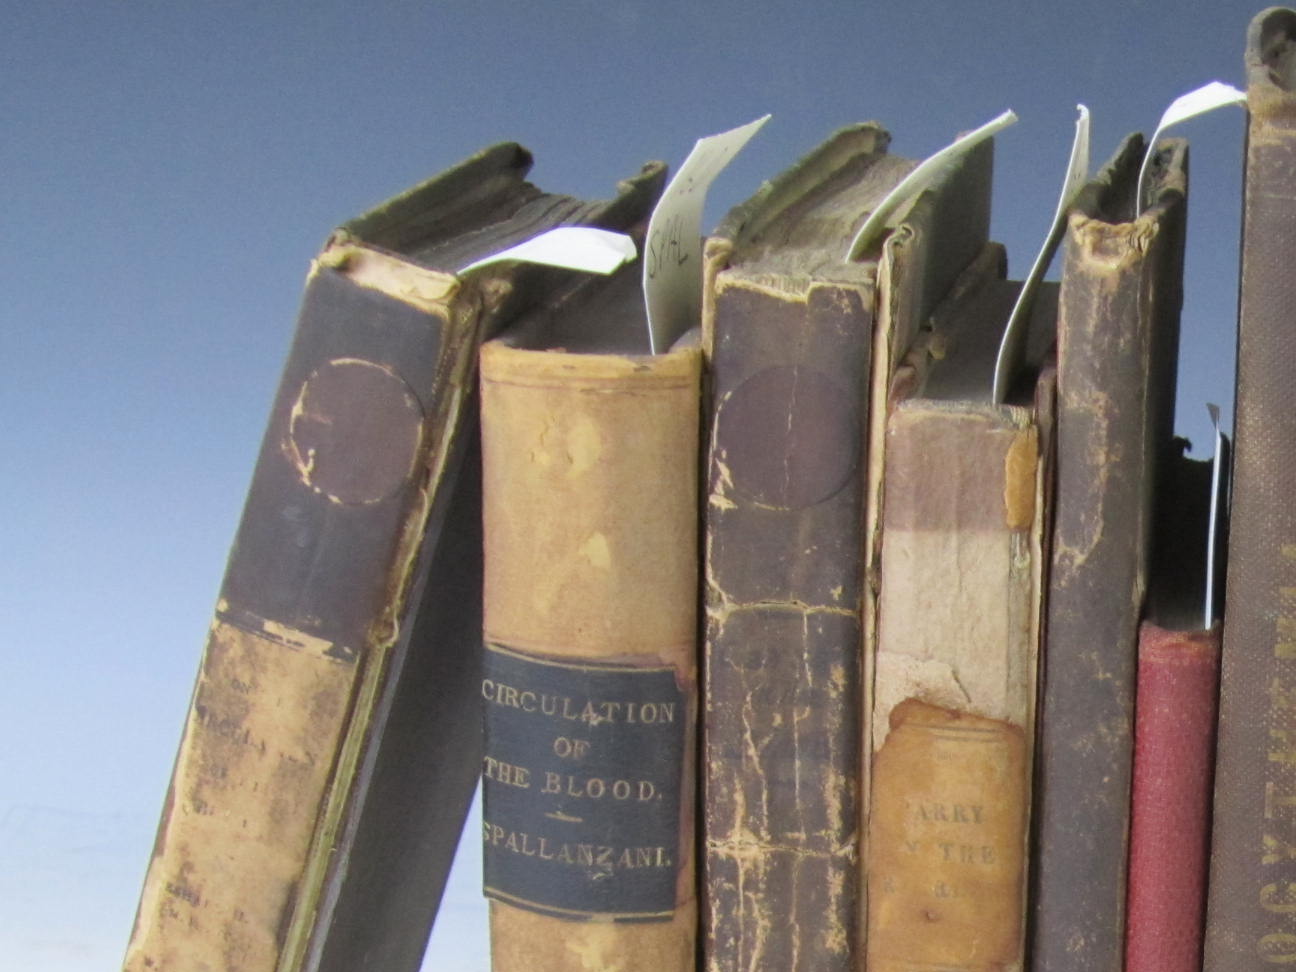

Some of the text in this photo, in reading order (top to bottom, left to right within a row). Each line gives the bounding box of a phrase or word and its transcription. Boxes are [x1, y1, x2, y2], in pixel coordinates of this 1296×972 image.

[481, 677, 676, 724] CIRCULATION
[553, 736, 591, 759] OF
[483, 755, 664, 802] THE BLOOD.
